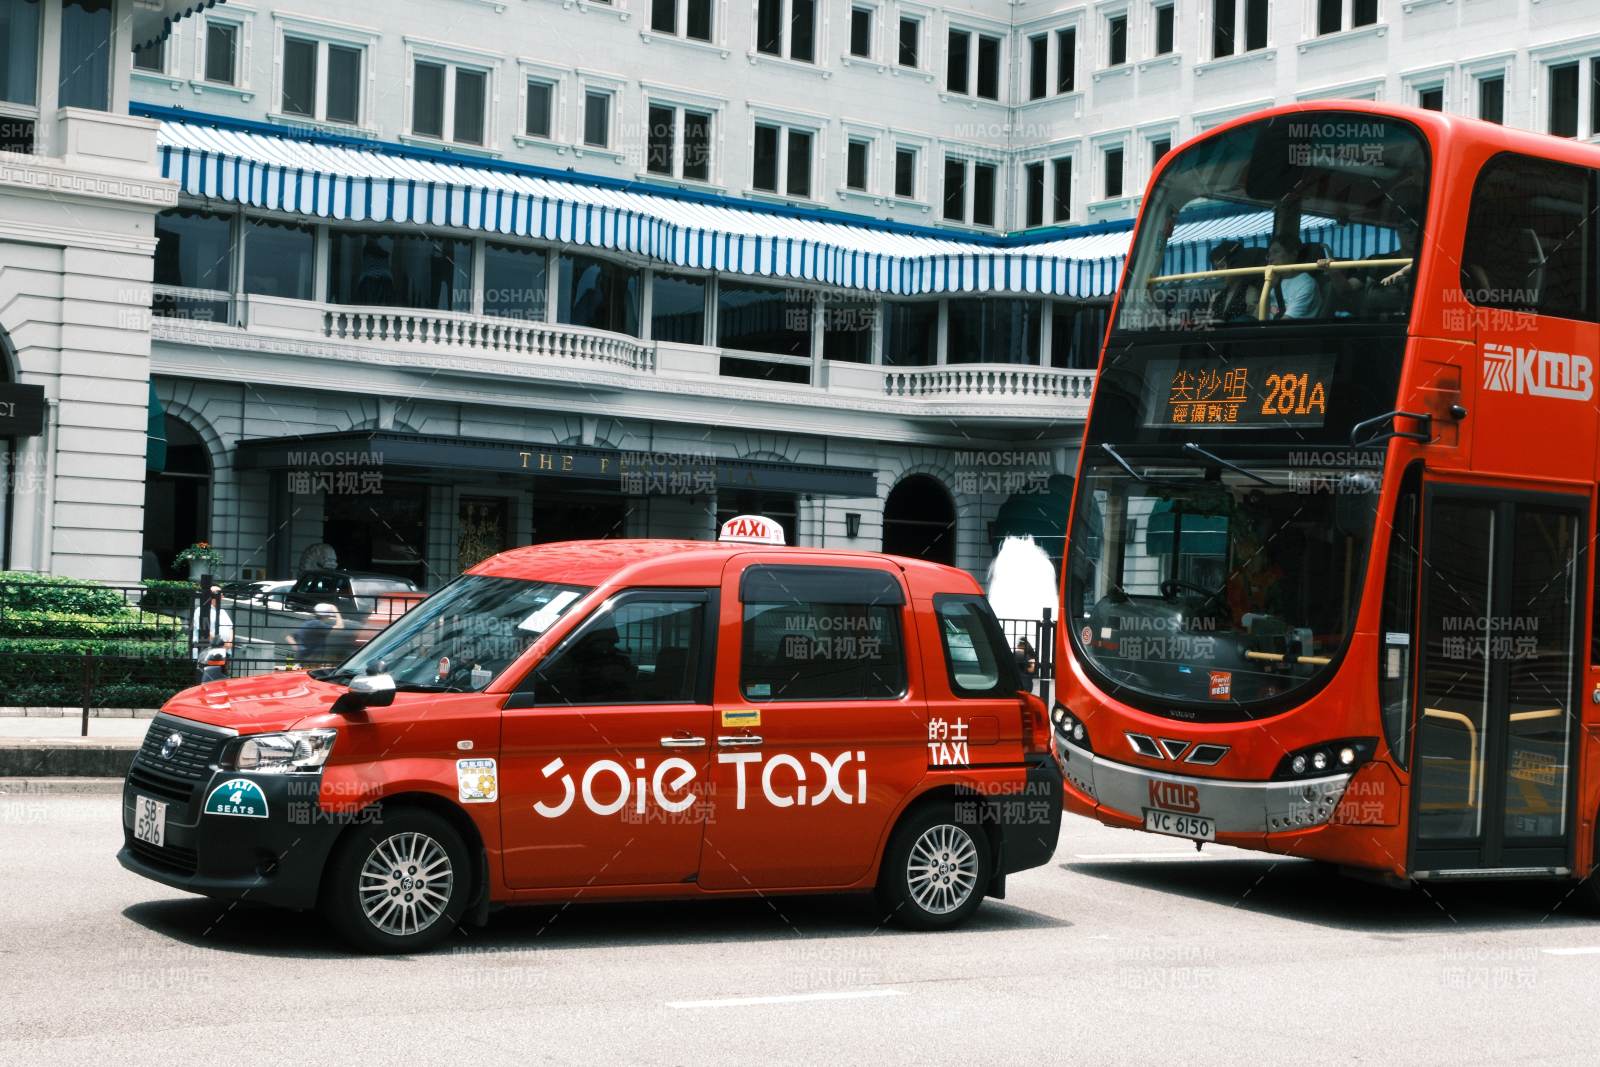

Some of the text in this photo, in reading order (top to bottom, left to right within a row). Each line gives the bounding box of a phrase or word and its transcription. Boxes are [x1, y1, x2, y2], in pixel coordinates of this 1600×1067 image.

[1169, 367, 1248, 401] 尖沙咀
[1261, 373, 1326, 415] 281A
[519, 452, 573, 471] THE
[727, 519, 766, 537] TAXI
[928, 717, 969, 741] 的士
[927, 742, 970, 766] TAXI
[227, 781, 253, 792] TAXI
[229, 790, 243, 805] 4
[144, 799, 157, 822] SB
[217, 804, 255, 815] SEATS
[137, 808, 160, 845] 5216
[1153, 812, 1209, 837] VC 6150
